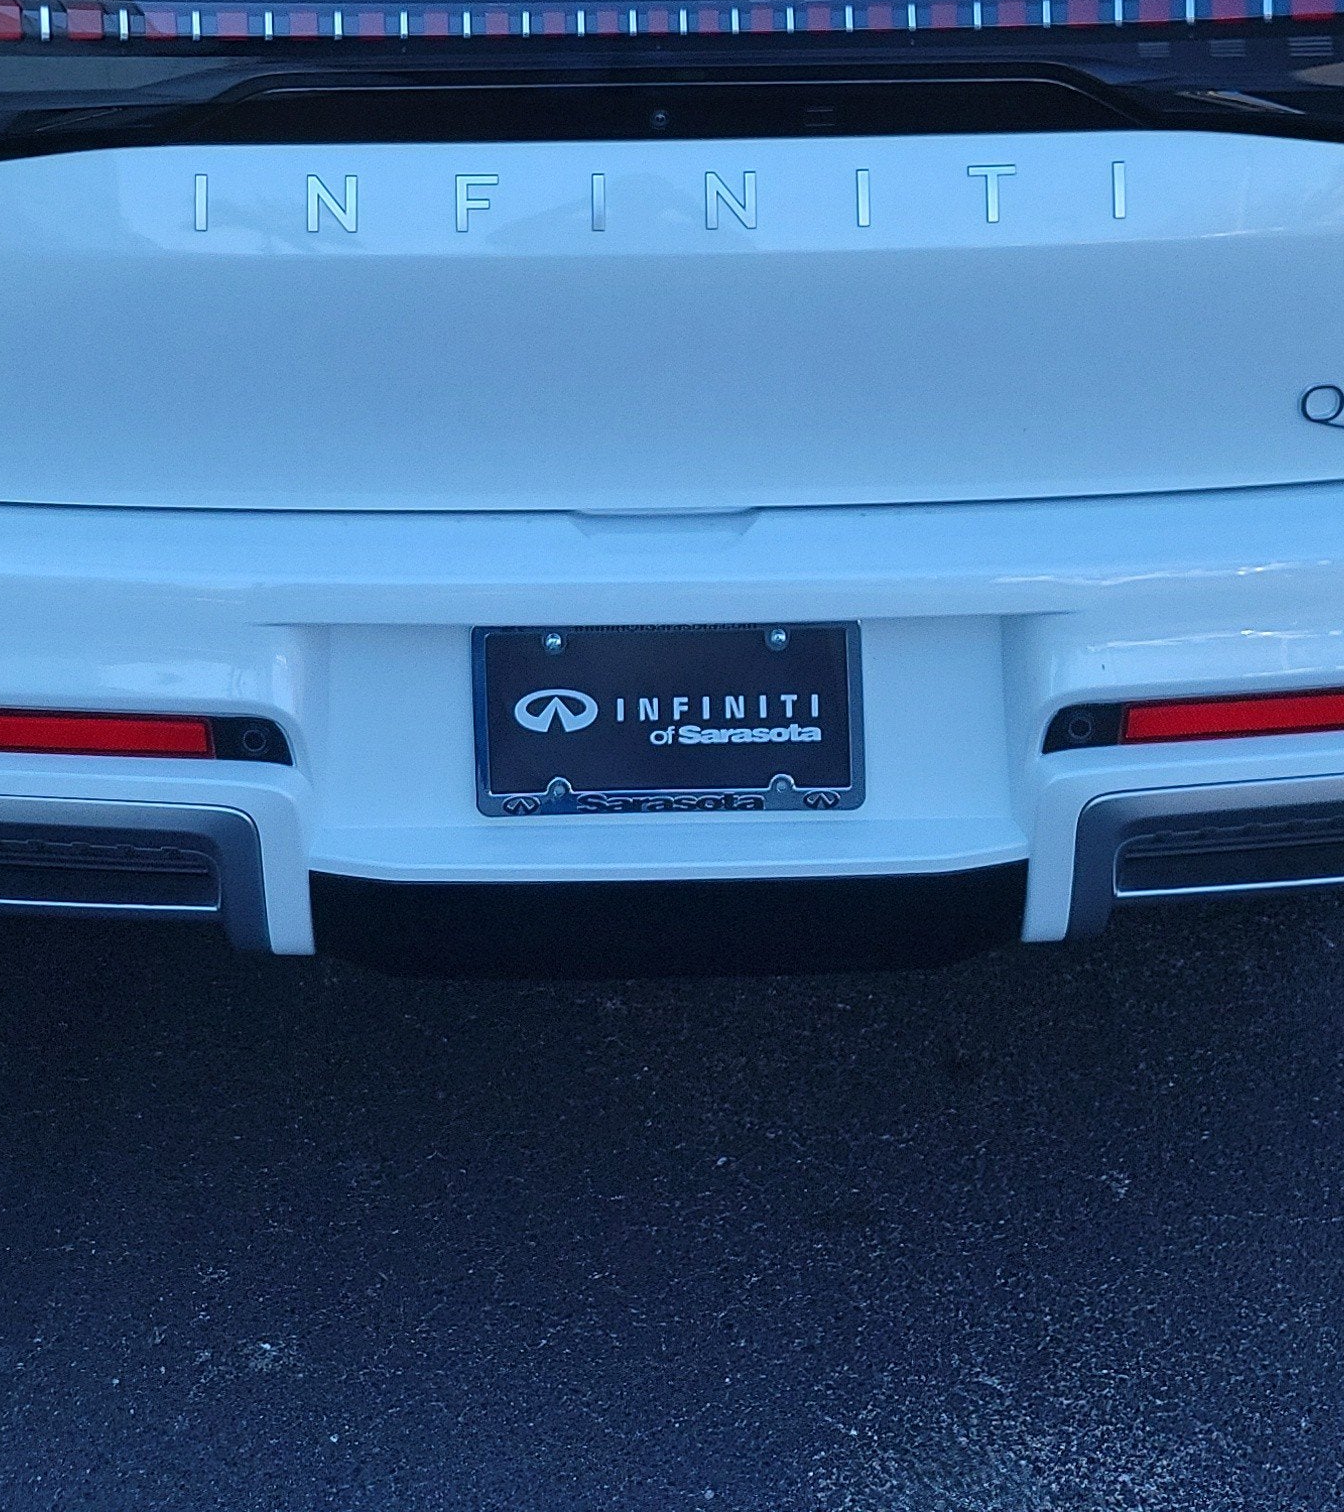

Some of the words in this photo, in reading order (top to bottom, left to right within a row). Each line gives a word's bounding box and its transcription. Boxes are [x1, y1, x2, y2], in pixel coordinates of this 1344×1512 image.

[194, 160, 1127, 233] INFINITI
[616, 693, 819, 722] INFINITI
[649, 725, 676, 746] of
[678, 723, 822, 745] Sarasota
[576, 791, 766, 812] Sarasota
